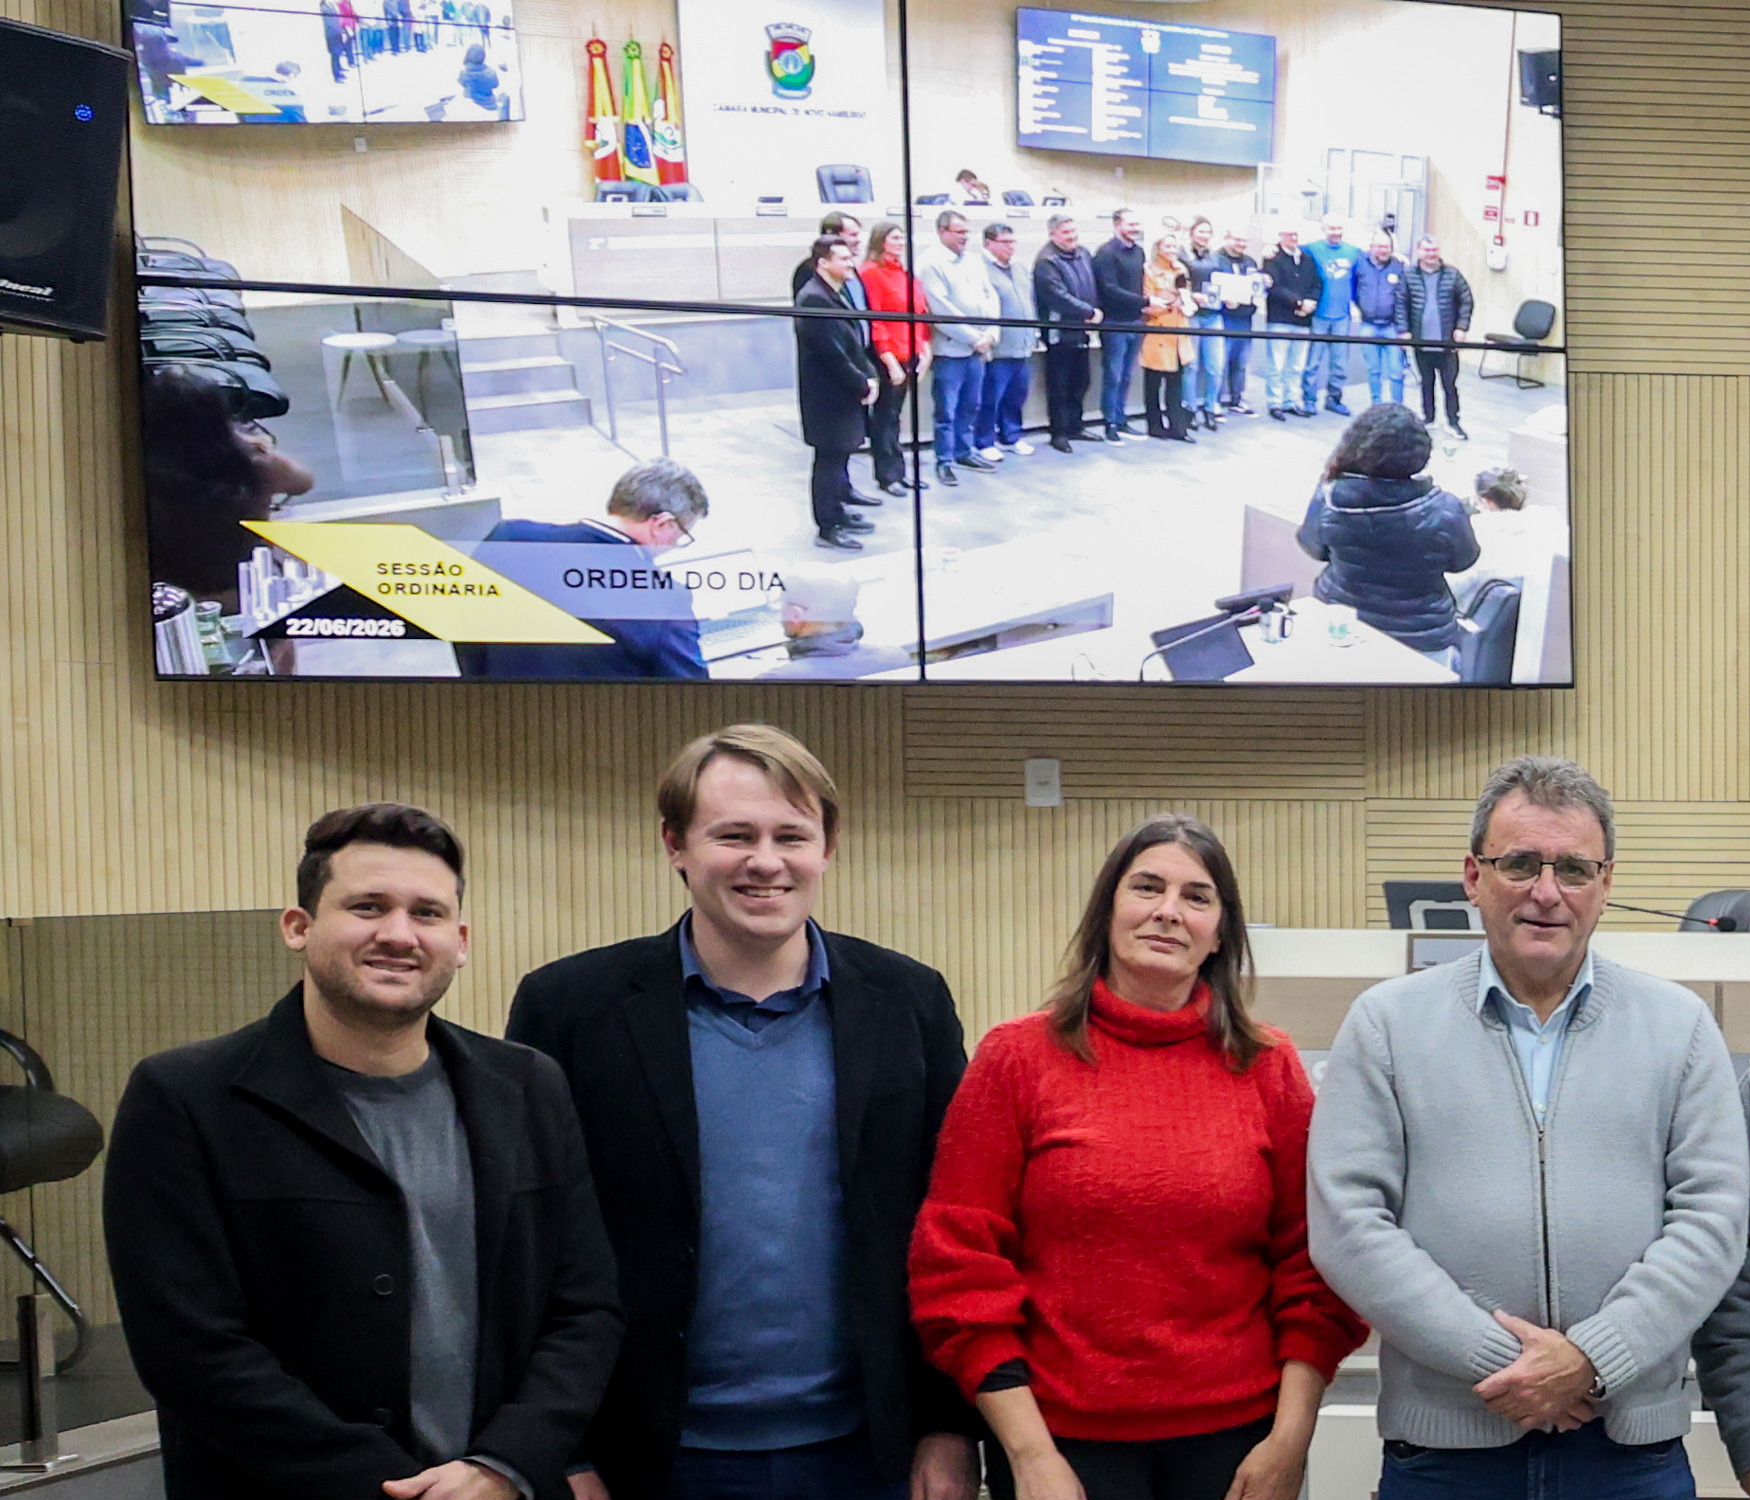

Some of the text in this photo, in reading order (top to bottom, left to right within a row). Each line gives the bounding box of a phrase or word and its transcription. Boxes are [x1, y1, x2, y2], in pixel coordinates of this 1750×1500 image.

[377, 561, 462, 576] SESSÃO
[563, 568, 786, 591] ORDEM DO DIA
[286, 618, 405, 637] 22/06/2026
